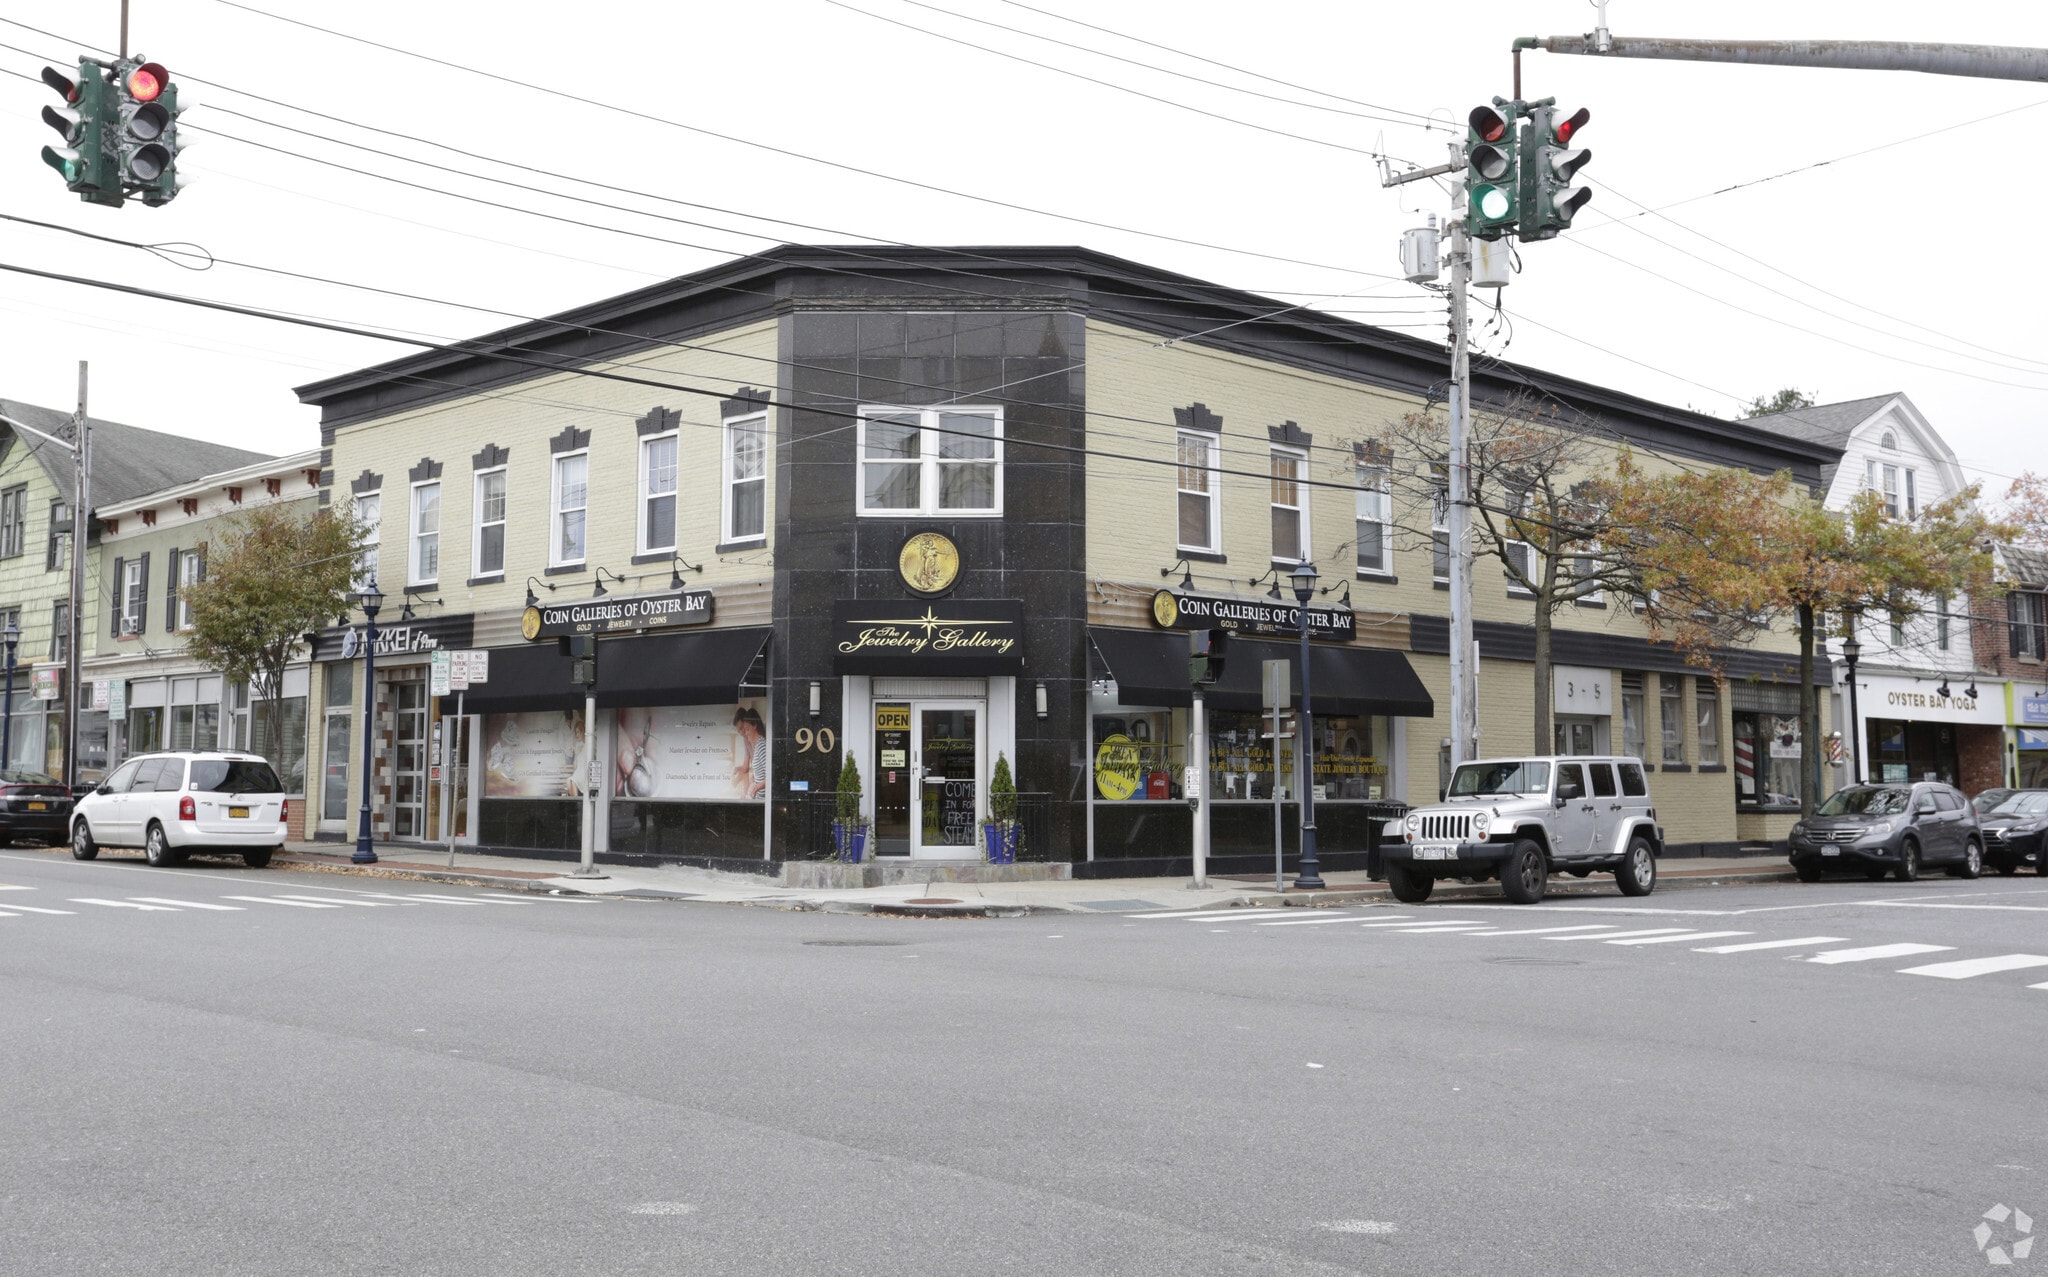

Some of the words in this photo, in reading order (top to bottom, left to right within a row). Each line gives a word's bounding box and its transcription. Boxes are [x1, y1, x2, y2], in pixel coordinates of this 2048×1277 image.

[543, 609, 570, 625] COIN
[571, 605, 622, 622] GALLERIES
[624, 602, 638, 616] OF
[640, 598, 682, 615] OYSTER
[685, 595, 707, 611] BAY
[1178, 597, 1210, 616] COIN
[1213, 601, 1270, 622] GALLERIES
[1272, 609, 1287, 623] OF
[1332, 612, 1352, 629] BAY
[576, 623, 592, 632] GOLD
[607, 619, 633, 630] JEWELRY
[649, 615, 667, 625] COINS
[875, 626, 900, 637] The
[1220, 619, 1238, 629] GOLD
[838, 628, 928, 654] Jewelry
[932, 628, 1015, 654] Gallery
[1567, 681, 1574, 698] 3
[1594, 683, 1601, 700] 5
[1887, 691, 1926, 708] OYSTER
[1929, 696, 1947, 709] BAY
[1950, 697, 1977, 711] YOGA
[877, 713, 909, 726] OPEN
[795, 727, 835, 753] 90
[1247, 762, 1264, 772] GOLD
[945, 800, 957, 809] IN
[947, 811, 973, 825] FREE
